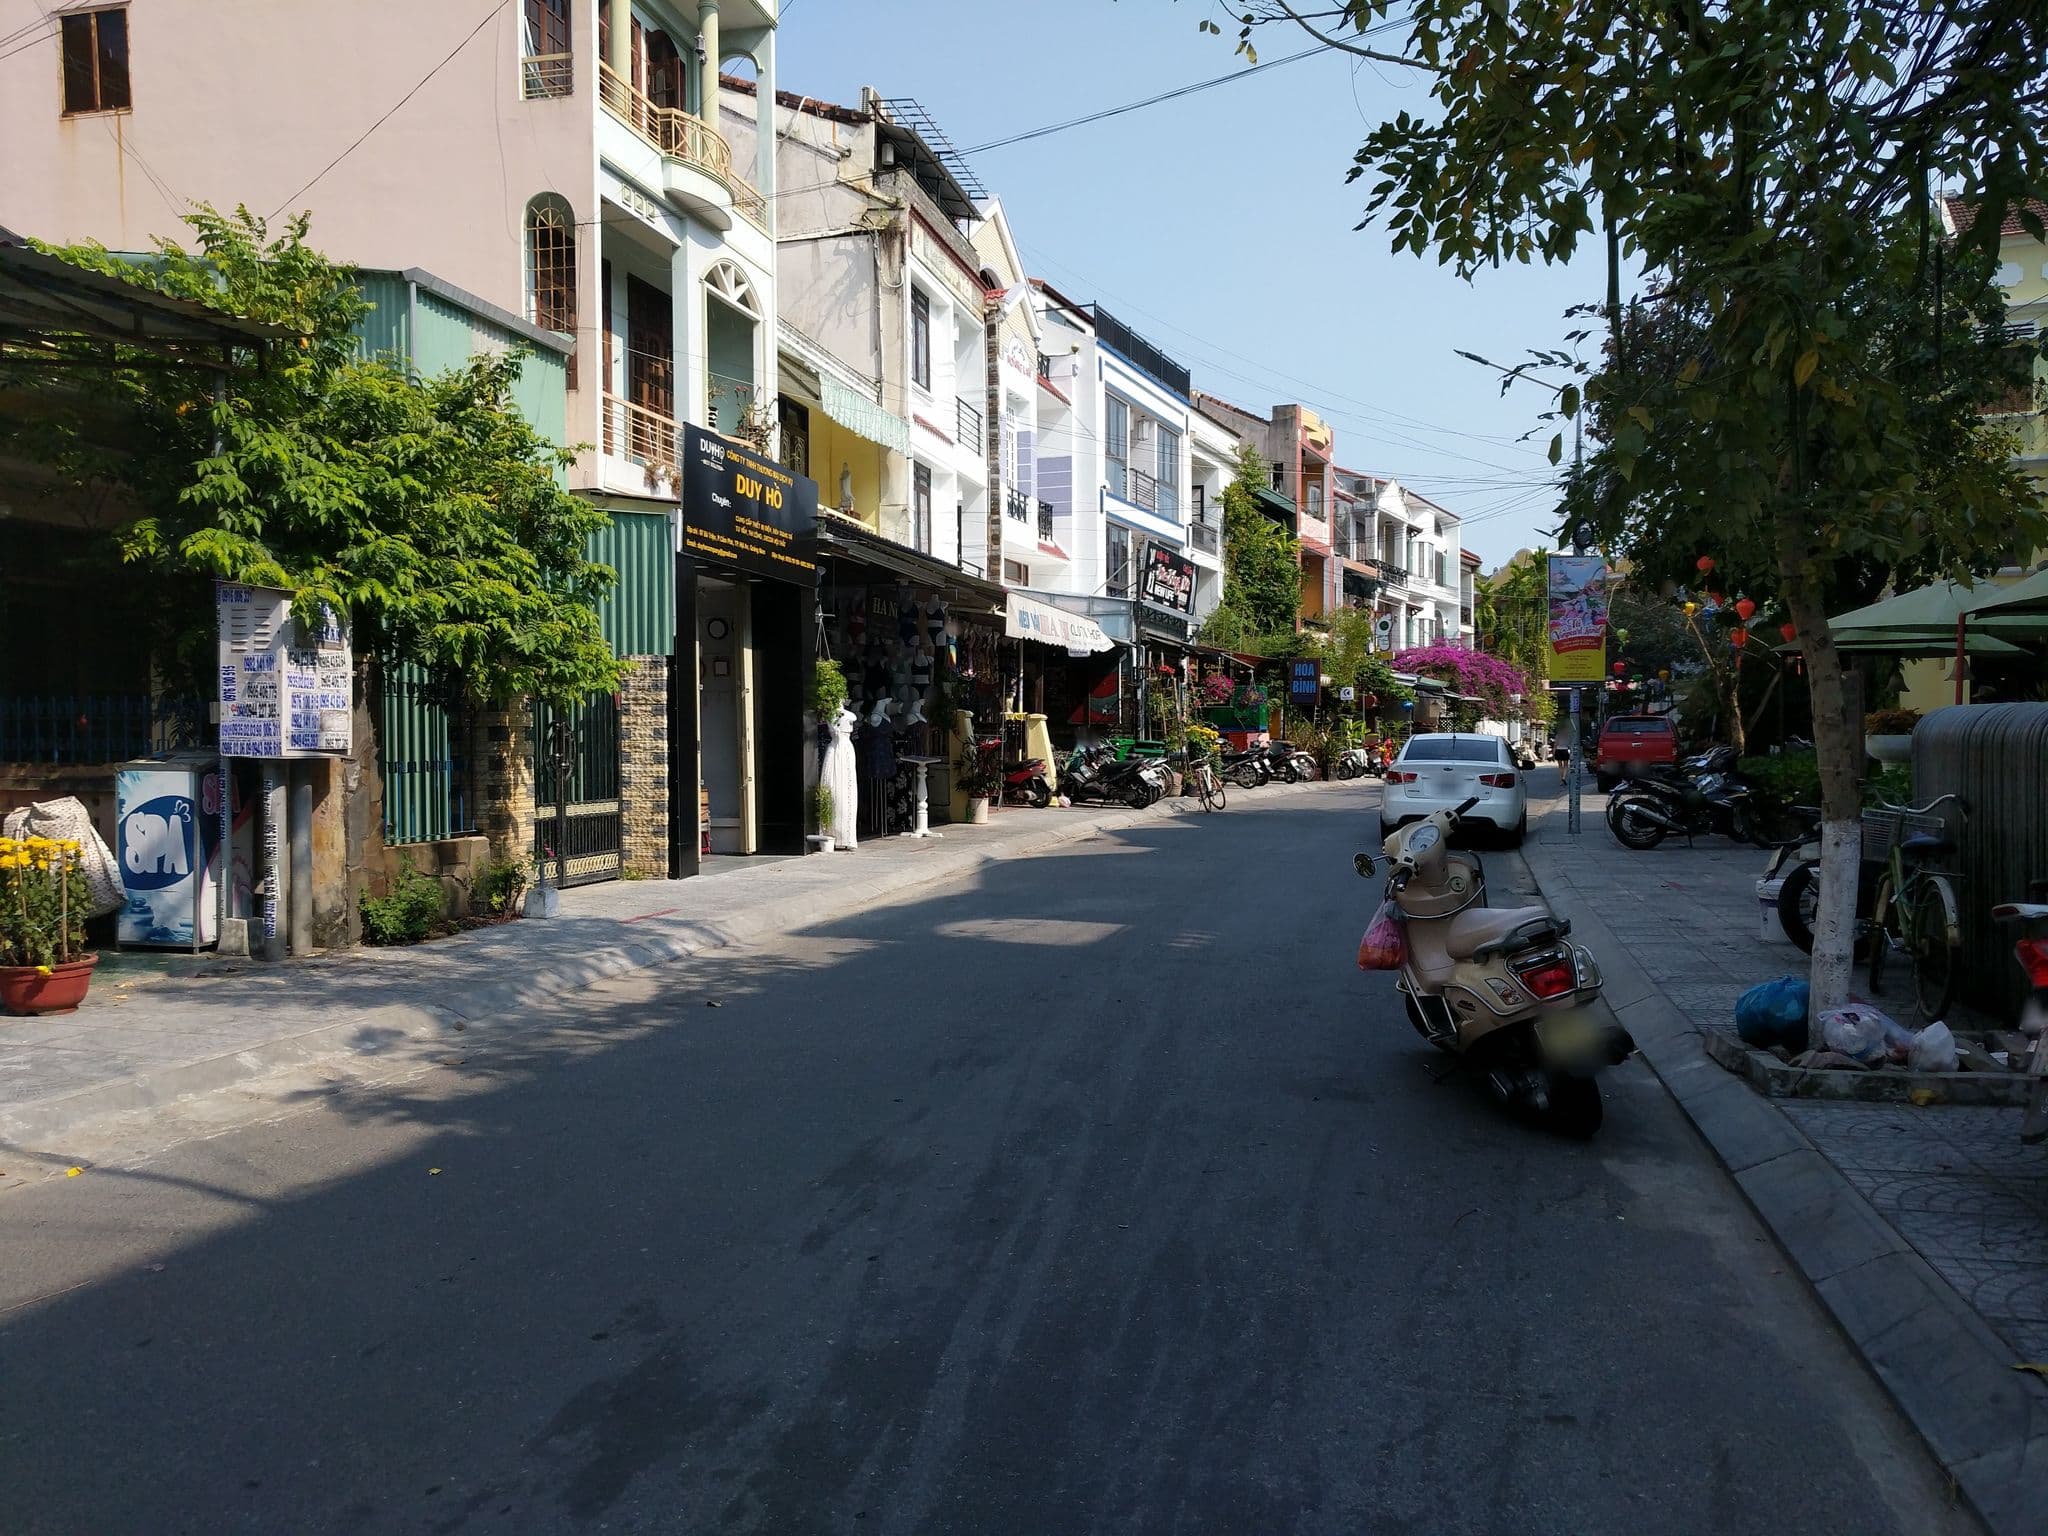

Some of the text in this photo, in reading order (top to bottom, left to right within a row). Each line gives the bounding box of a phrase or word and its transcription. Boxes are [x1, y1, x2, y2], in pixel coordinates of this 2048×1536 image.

[736, 474, 762, 501] DUY
[222, 666, 236, 702] 0976 100 515
[1292, 678, 1316, 693] BÌNH
[125, 812, 188, 875] SPA
